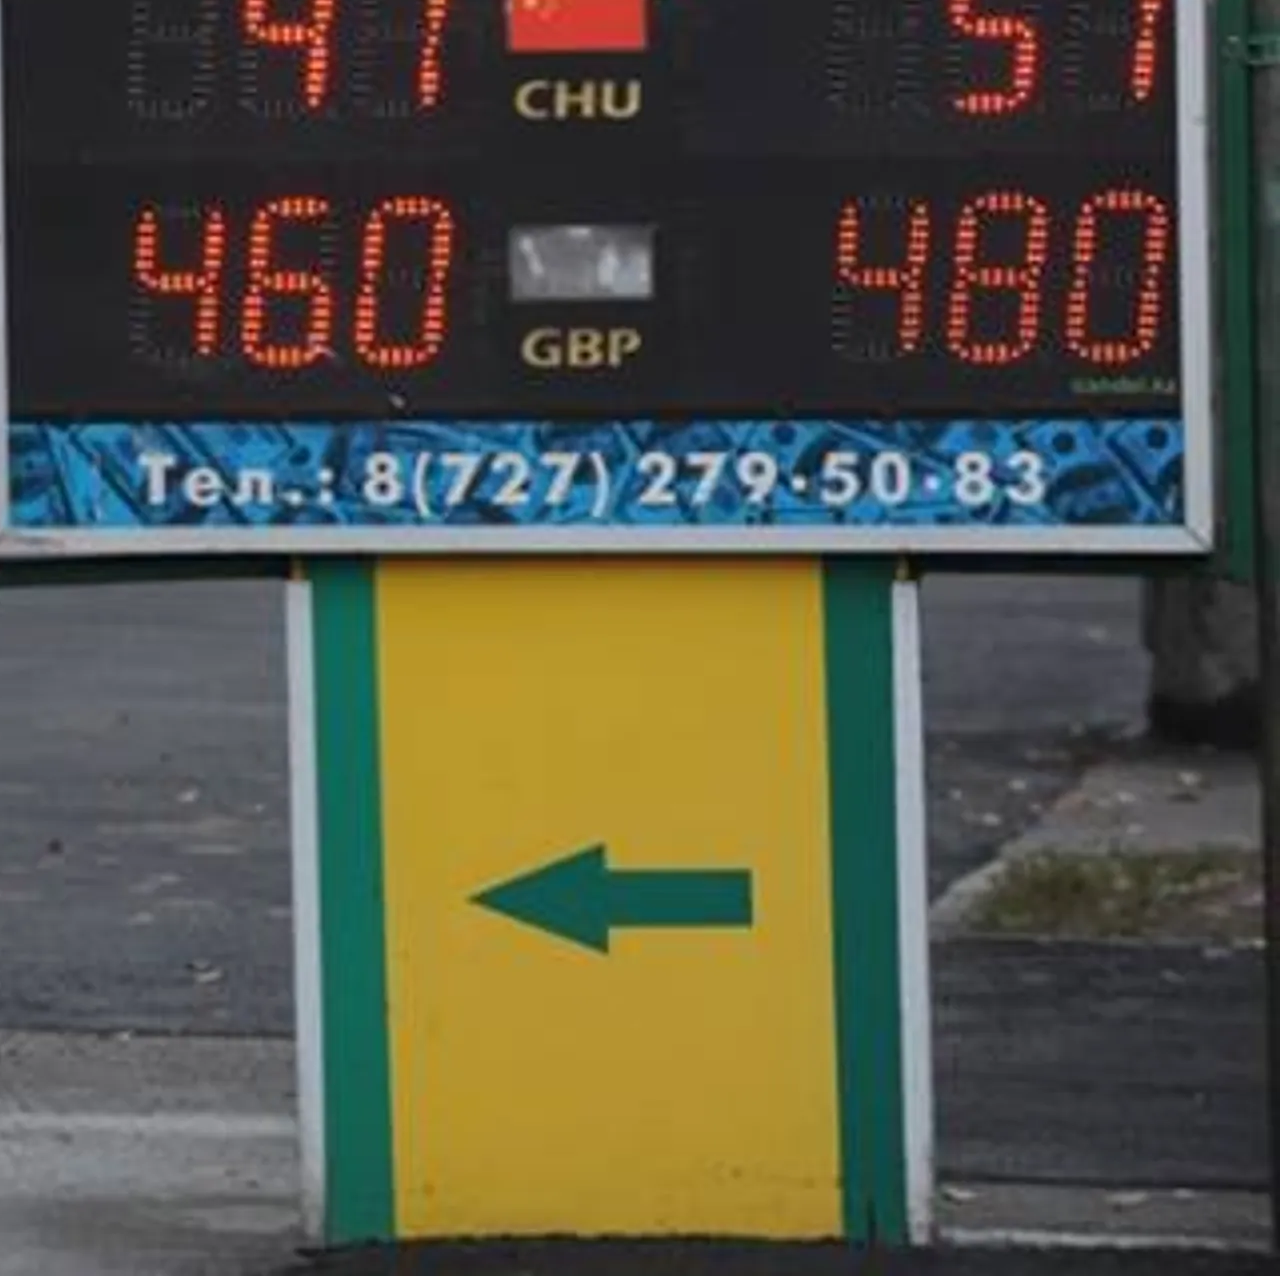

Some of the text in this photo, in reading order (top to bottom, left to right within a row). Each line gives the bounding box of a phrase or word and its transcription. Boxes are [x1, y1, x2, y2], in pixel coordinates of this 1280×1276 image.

[513, 78, 642, 120] CHU
[132, 194, 456, 370] 460
[836, 188, 1170, 366] 480
[520, 327, 643, 369] GBP
[139, 453, 334, 506] Тел.:
